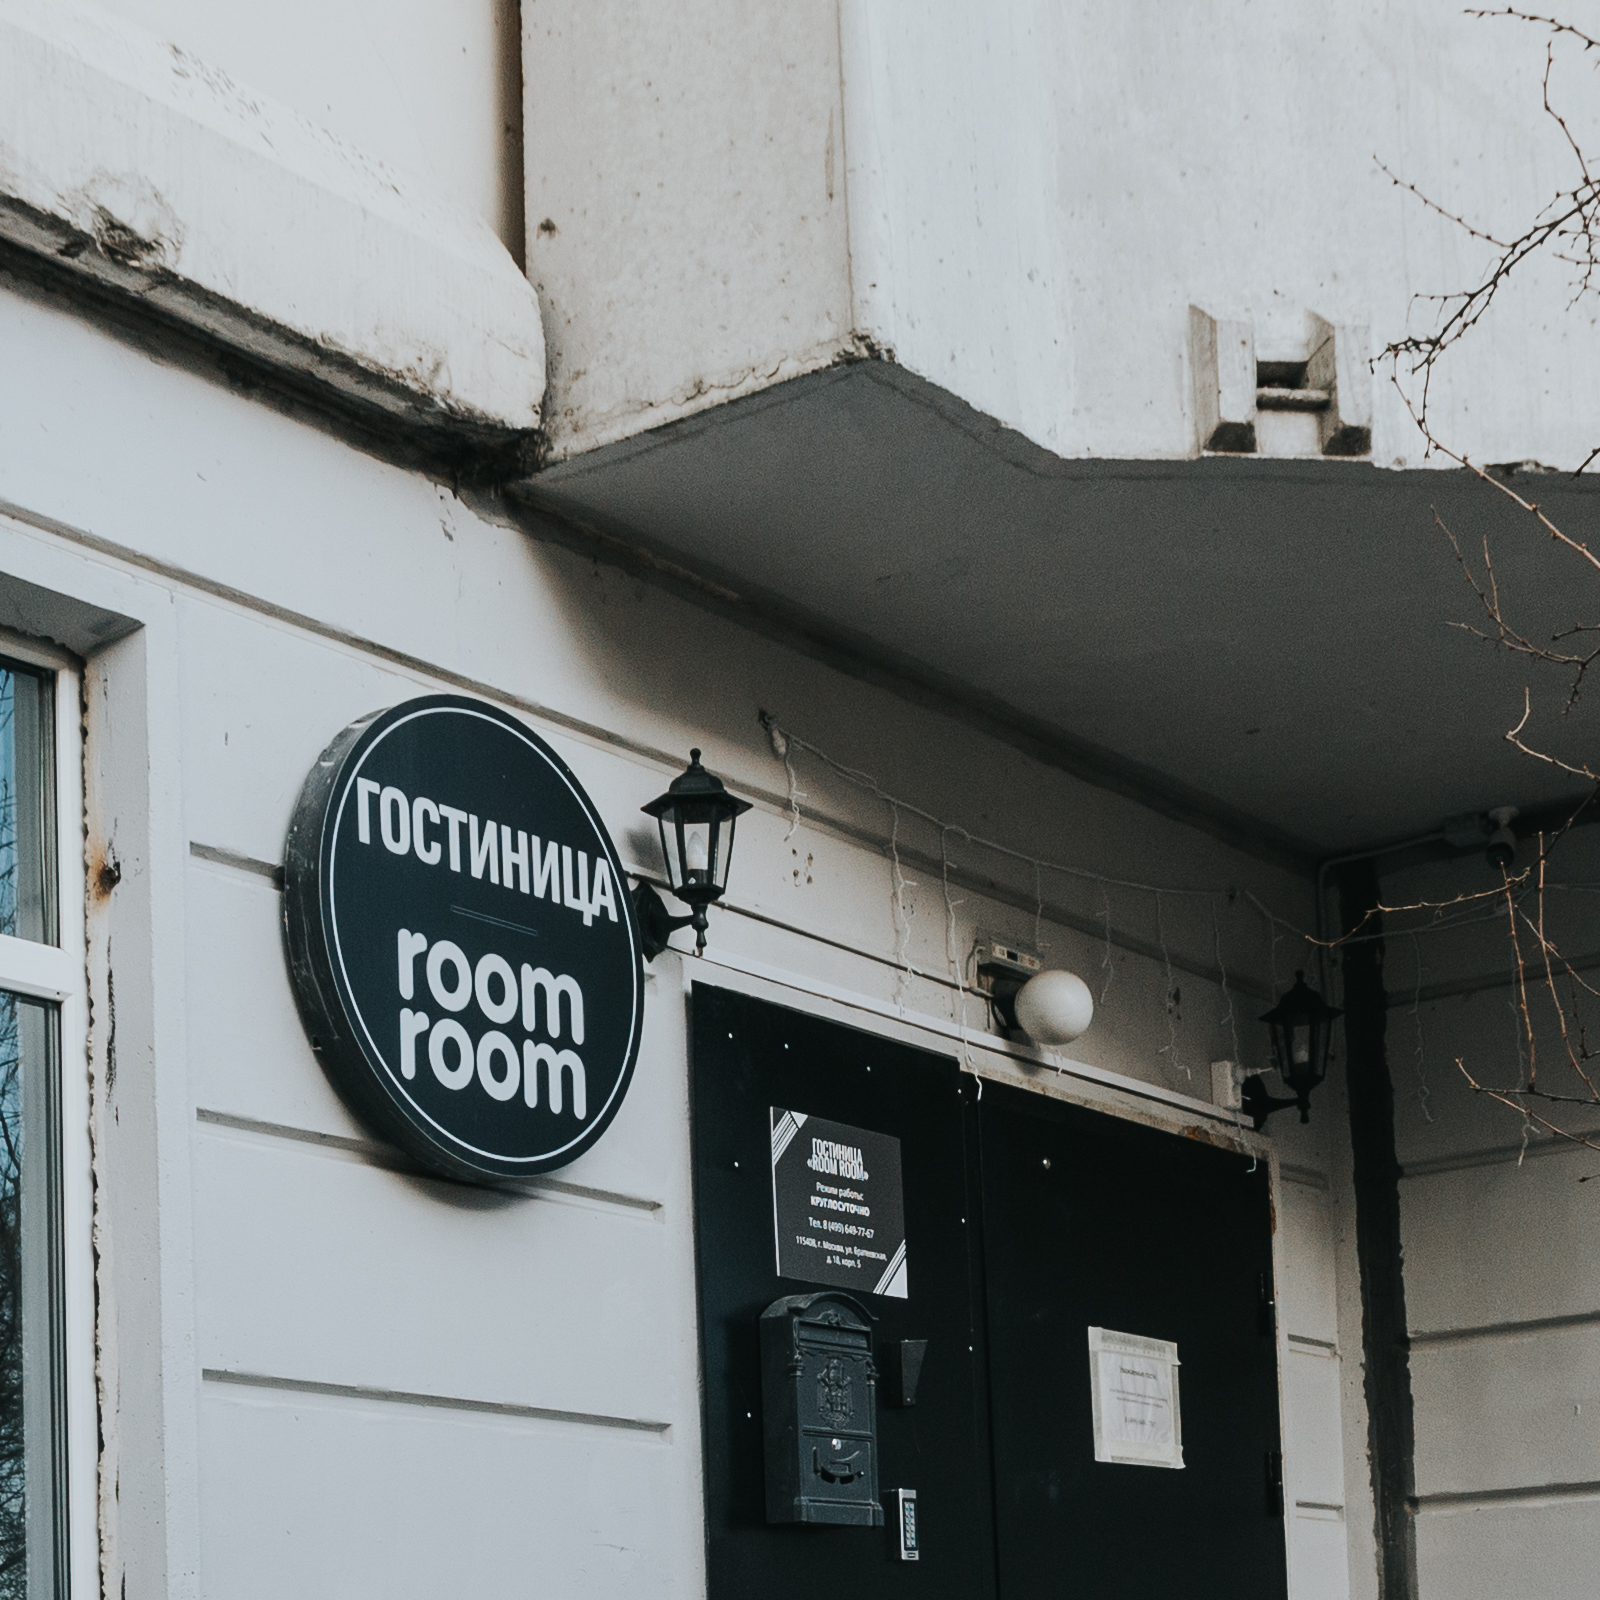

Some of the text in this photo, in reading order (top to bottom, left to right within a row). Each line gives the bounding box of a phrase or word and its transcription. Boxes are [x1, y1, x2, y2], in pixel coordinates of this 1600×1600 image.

[356, 776, 619, 926] ГОСТИНИЦА
[397, 927, 585, 1046] room
[399, 1006, 587, 1120] room
[812, 1138, 863, 1164] ГОСТИНИЦА
[807, 1154, 869, 1181] «ROOM ROOM»
[811, 1196, 870, 1216] КРУГЛОСУТОЧНО
[809, 1217, 822, 1229] Тел.
[823, 1220, 828, 1230] 8
